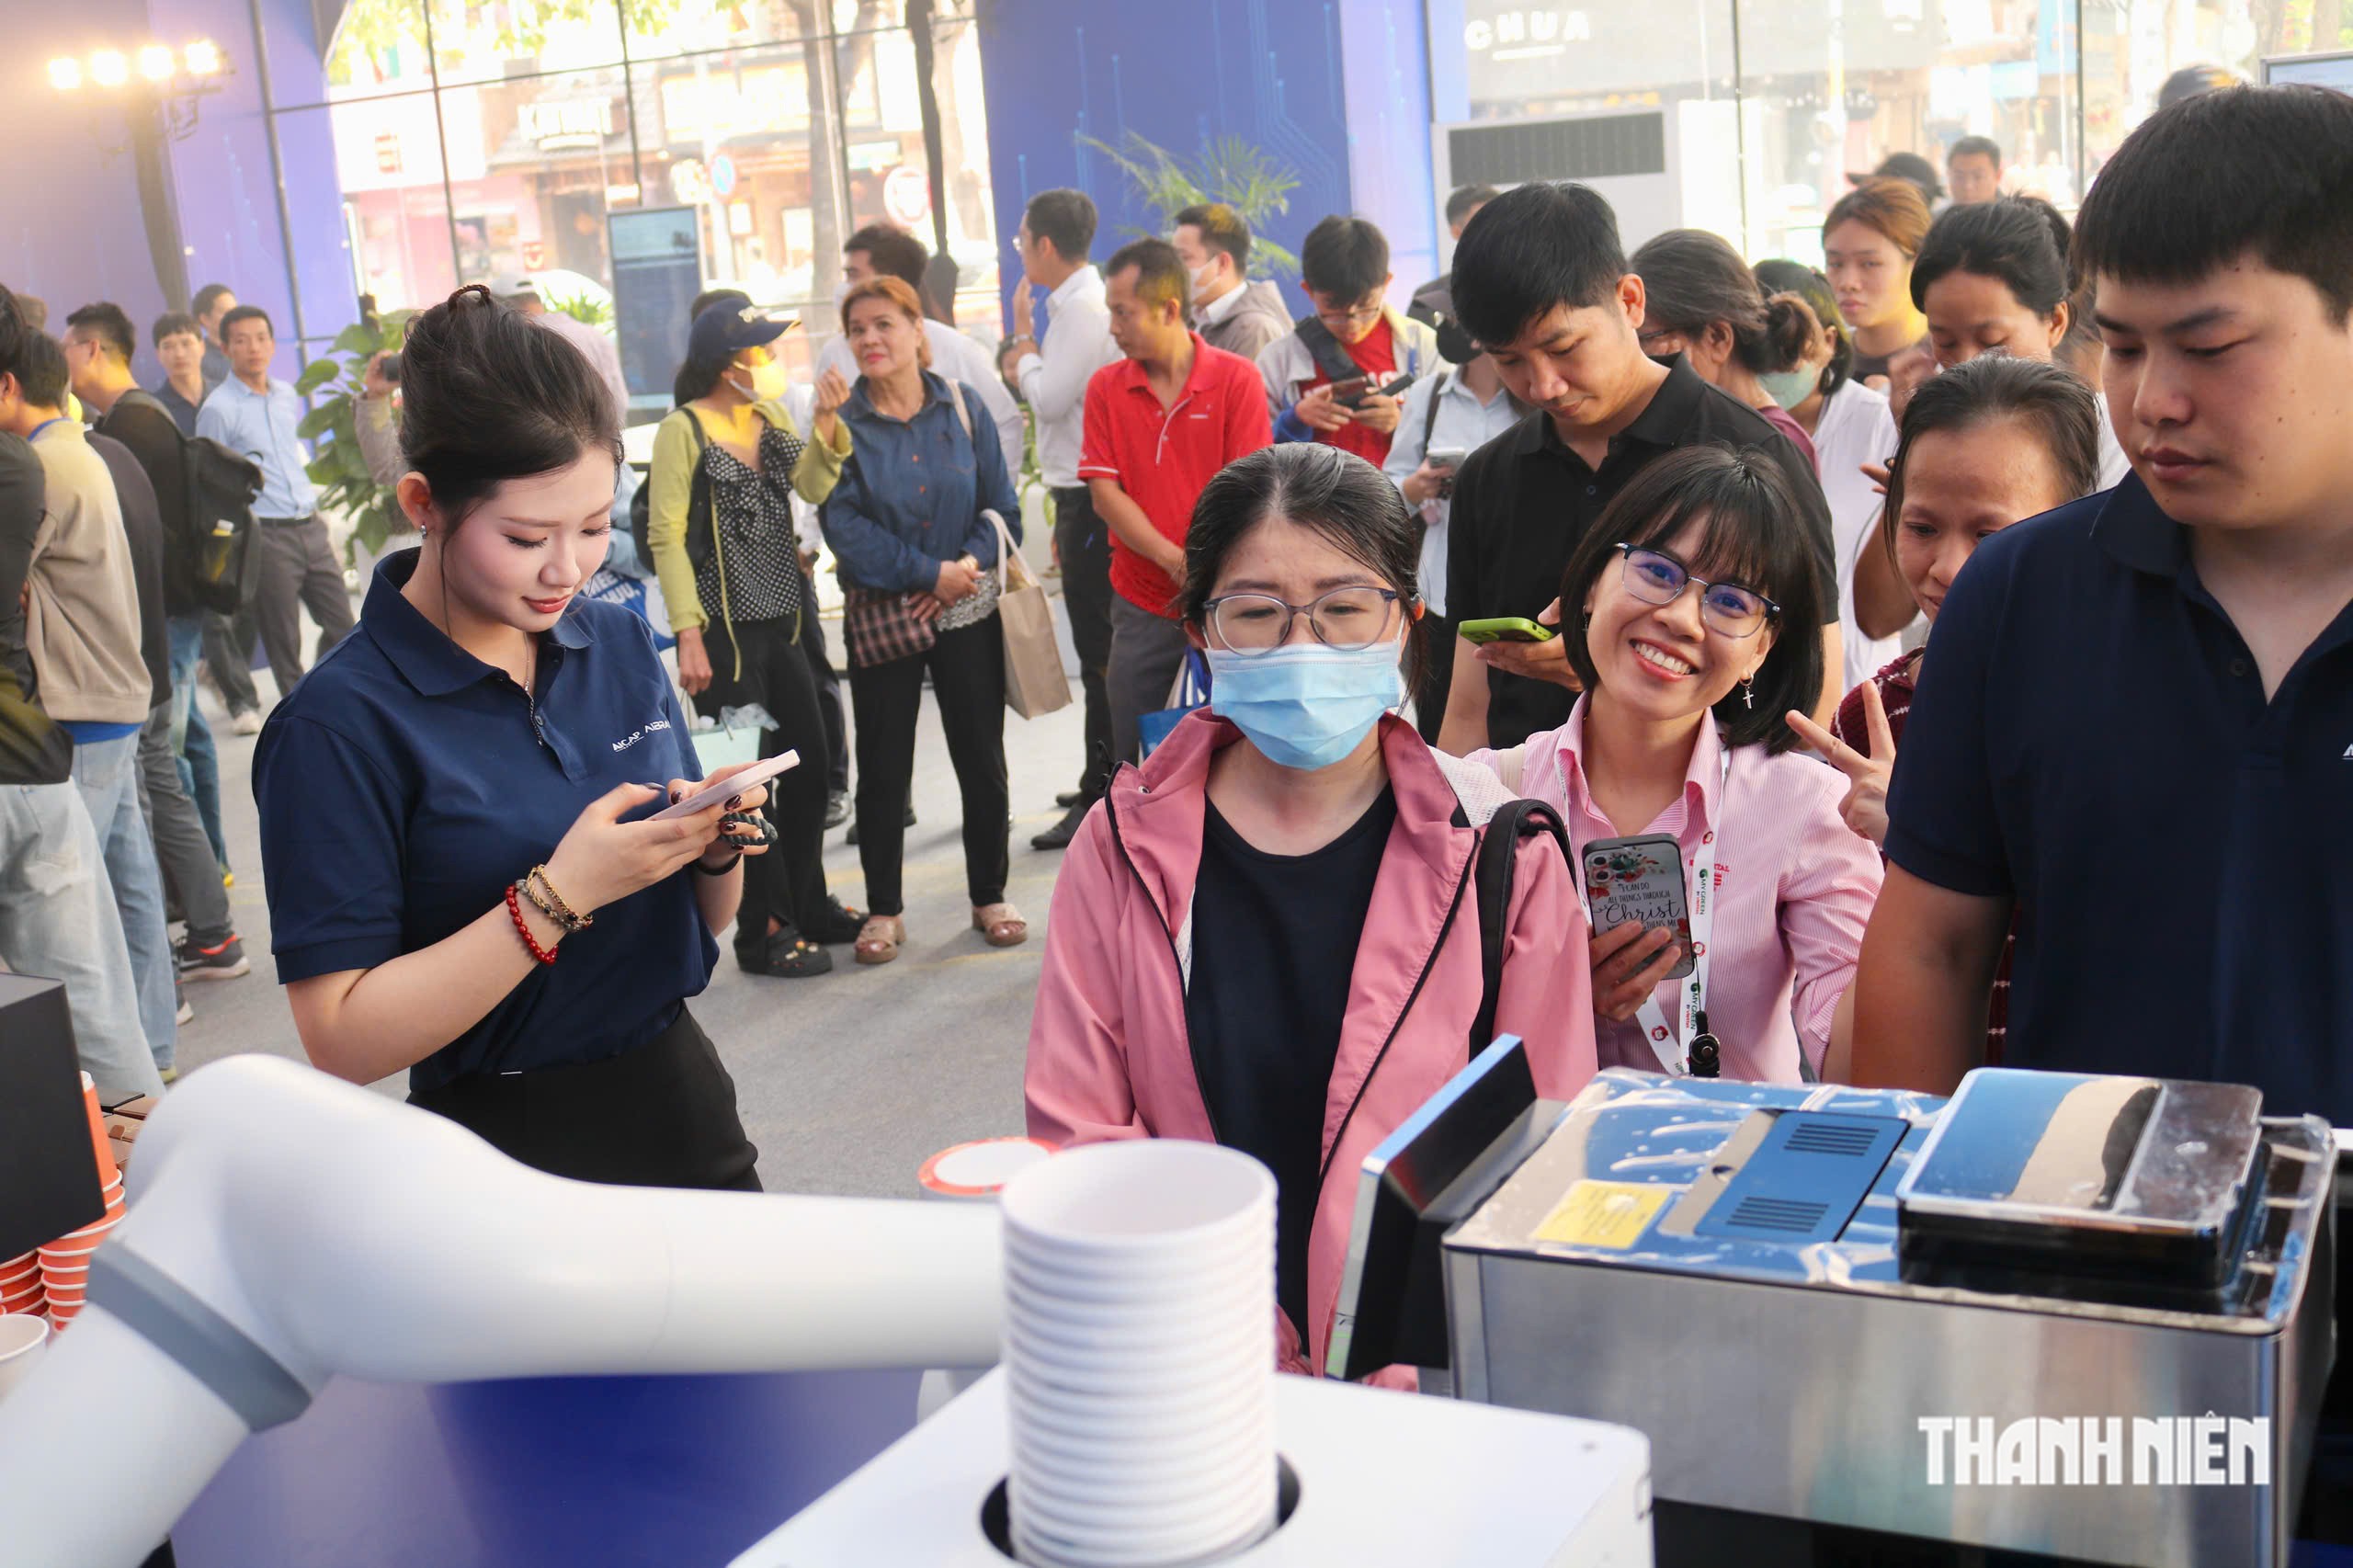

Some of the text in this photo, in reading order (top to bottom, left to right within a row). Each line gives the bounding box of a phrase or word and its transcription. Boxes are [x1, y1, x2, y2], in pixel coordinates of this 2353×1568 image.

[1700, 879, 1707, 890] MY
[1606, 899, 1680, 924] Christ
[1692, 993, 1699, 1005] MY
